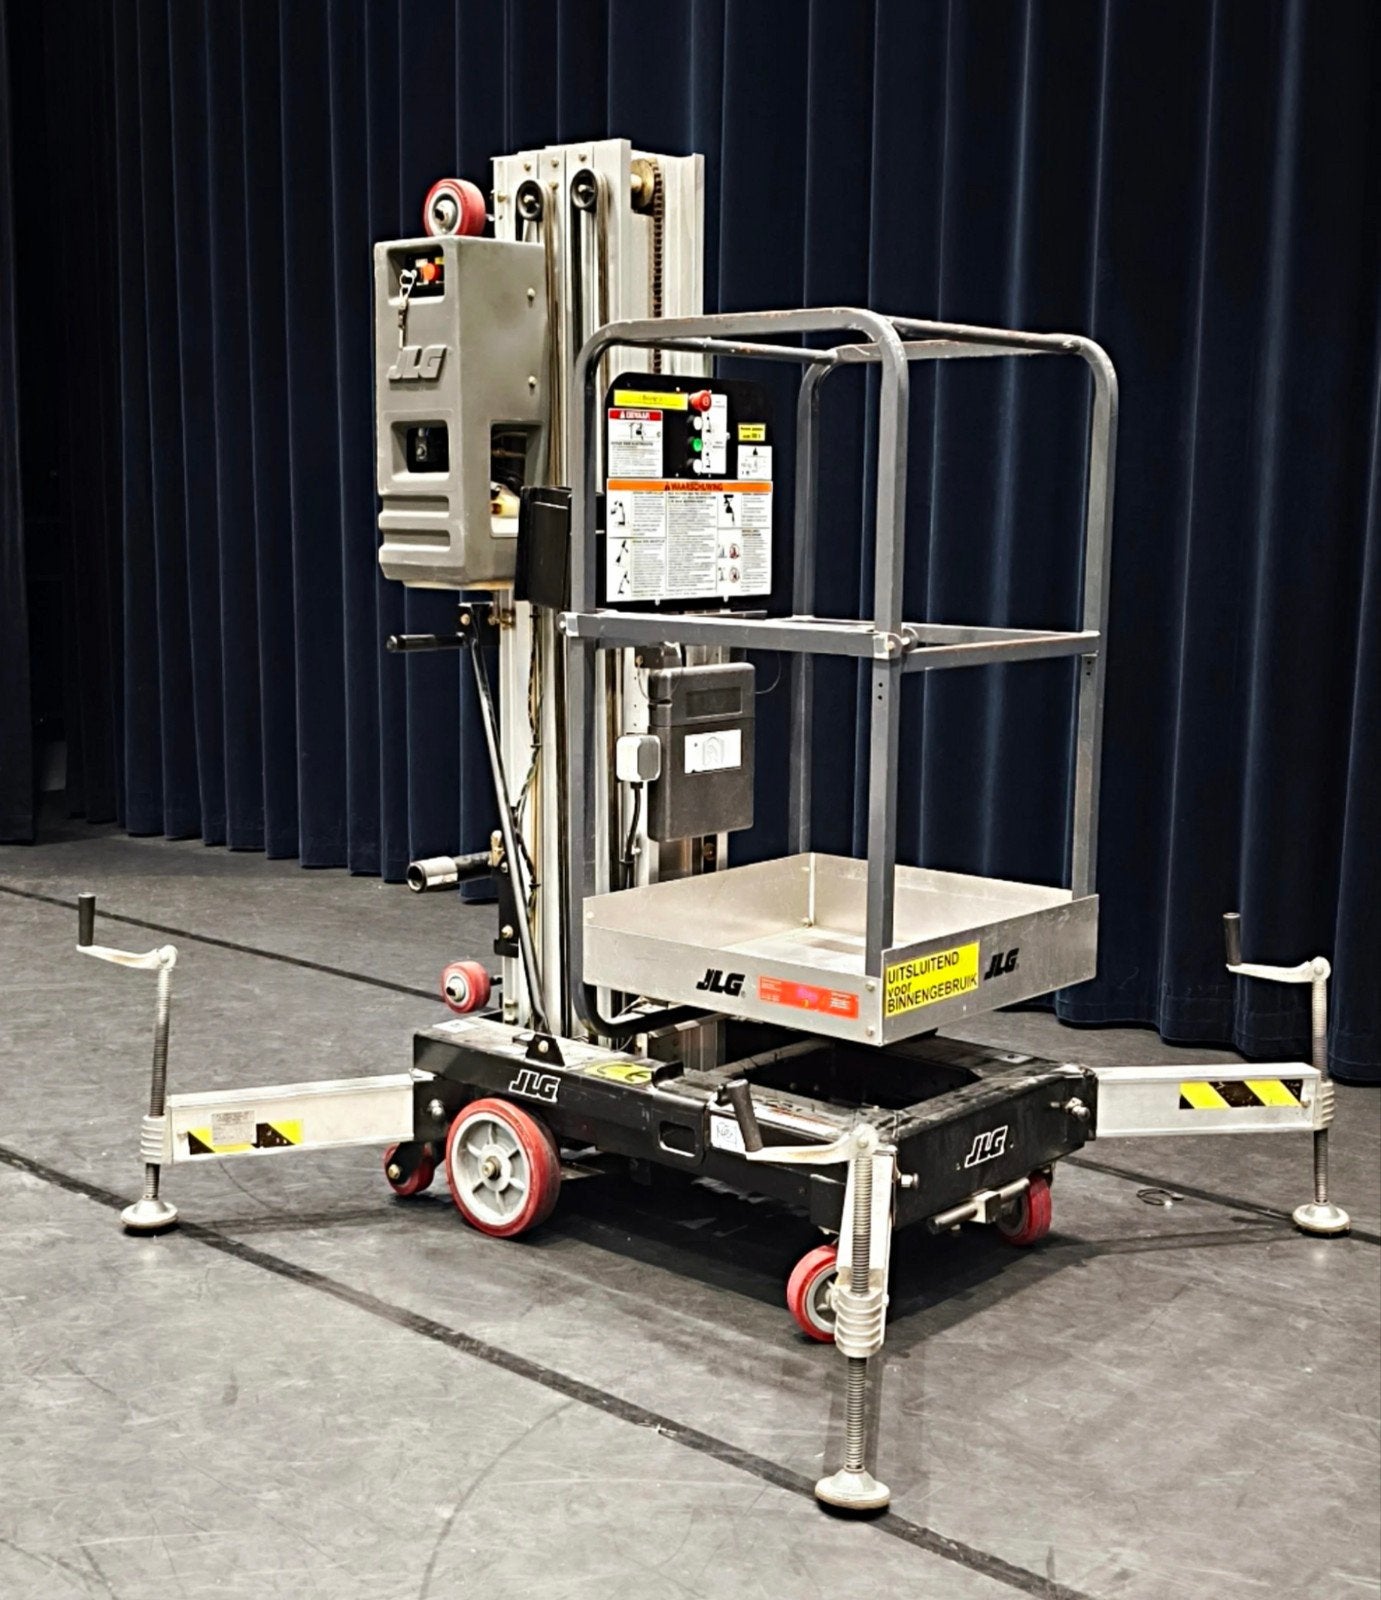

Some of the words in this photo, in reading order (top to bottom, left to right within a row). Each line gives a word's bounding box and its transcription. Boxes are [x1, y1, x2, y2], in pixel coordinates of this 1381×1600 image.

[387, 344, 448, 384] JLG
[888, 951, 960, 984] UITSLUITEND
[984, 948, 1020, 981] JLG
[696, 968, 745, 997] JLG
[887, 982, 912, 999] voor
[887, 973, 977, 1013] BINNENGEBRUIK
[509, 1069, 561, 1103] JLG
[964, 1125, 1009, 1168] JLG
